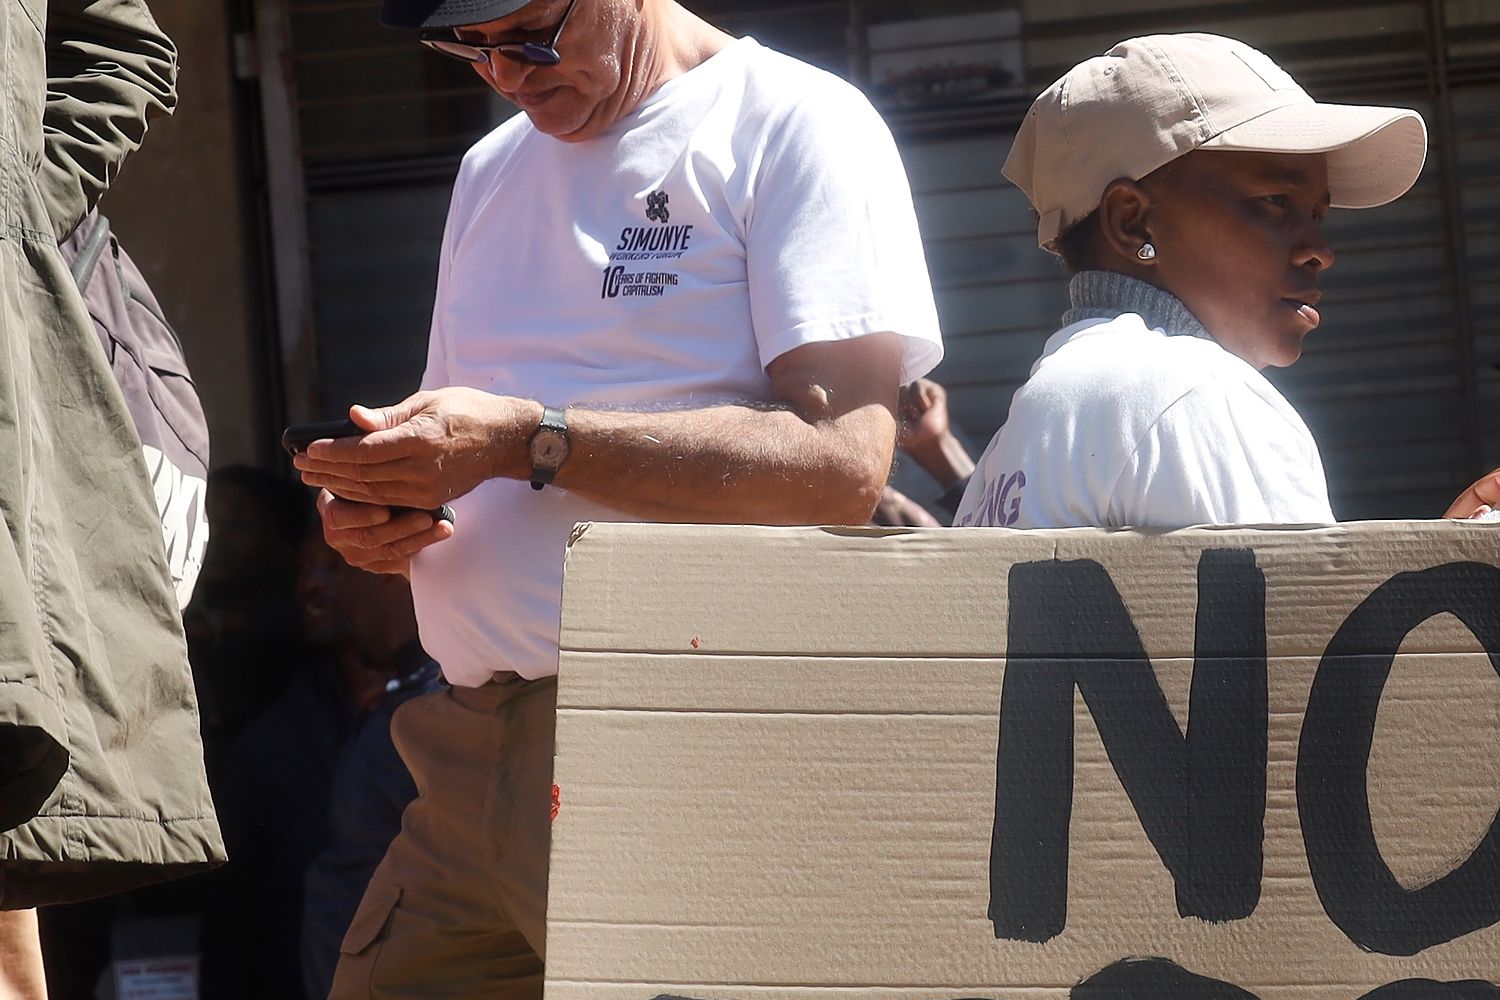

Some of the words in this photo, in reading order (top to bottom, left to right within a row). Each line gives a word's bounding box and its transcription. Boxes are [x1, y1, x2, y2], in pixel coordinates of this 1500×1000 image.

[616, 225, 694, 251] SIMUNYE
[602, 265, 625, 299] 10
[614, 273, 634, 285] YEARS
[634, 273, 646, 284] OF
[644, 272, 679, 285] FIGHTING
[622, 284, 664, 297] CAPITALISM
